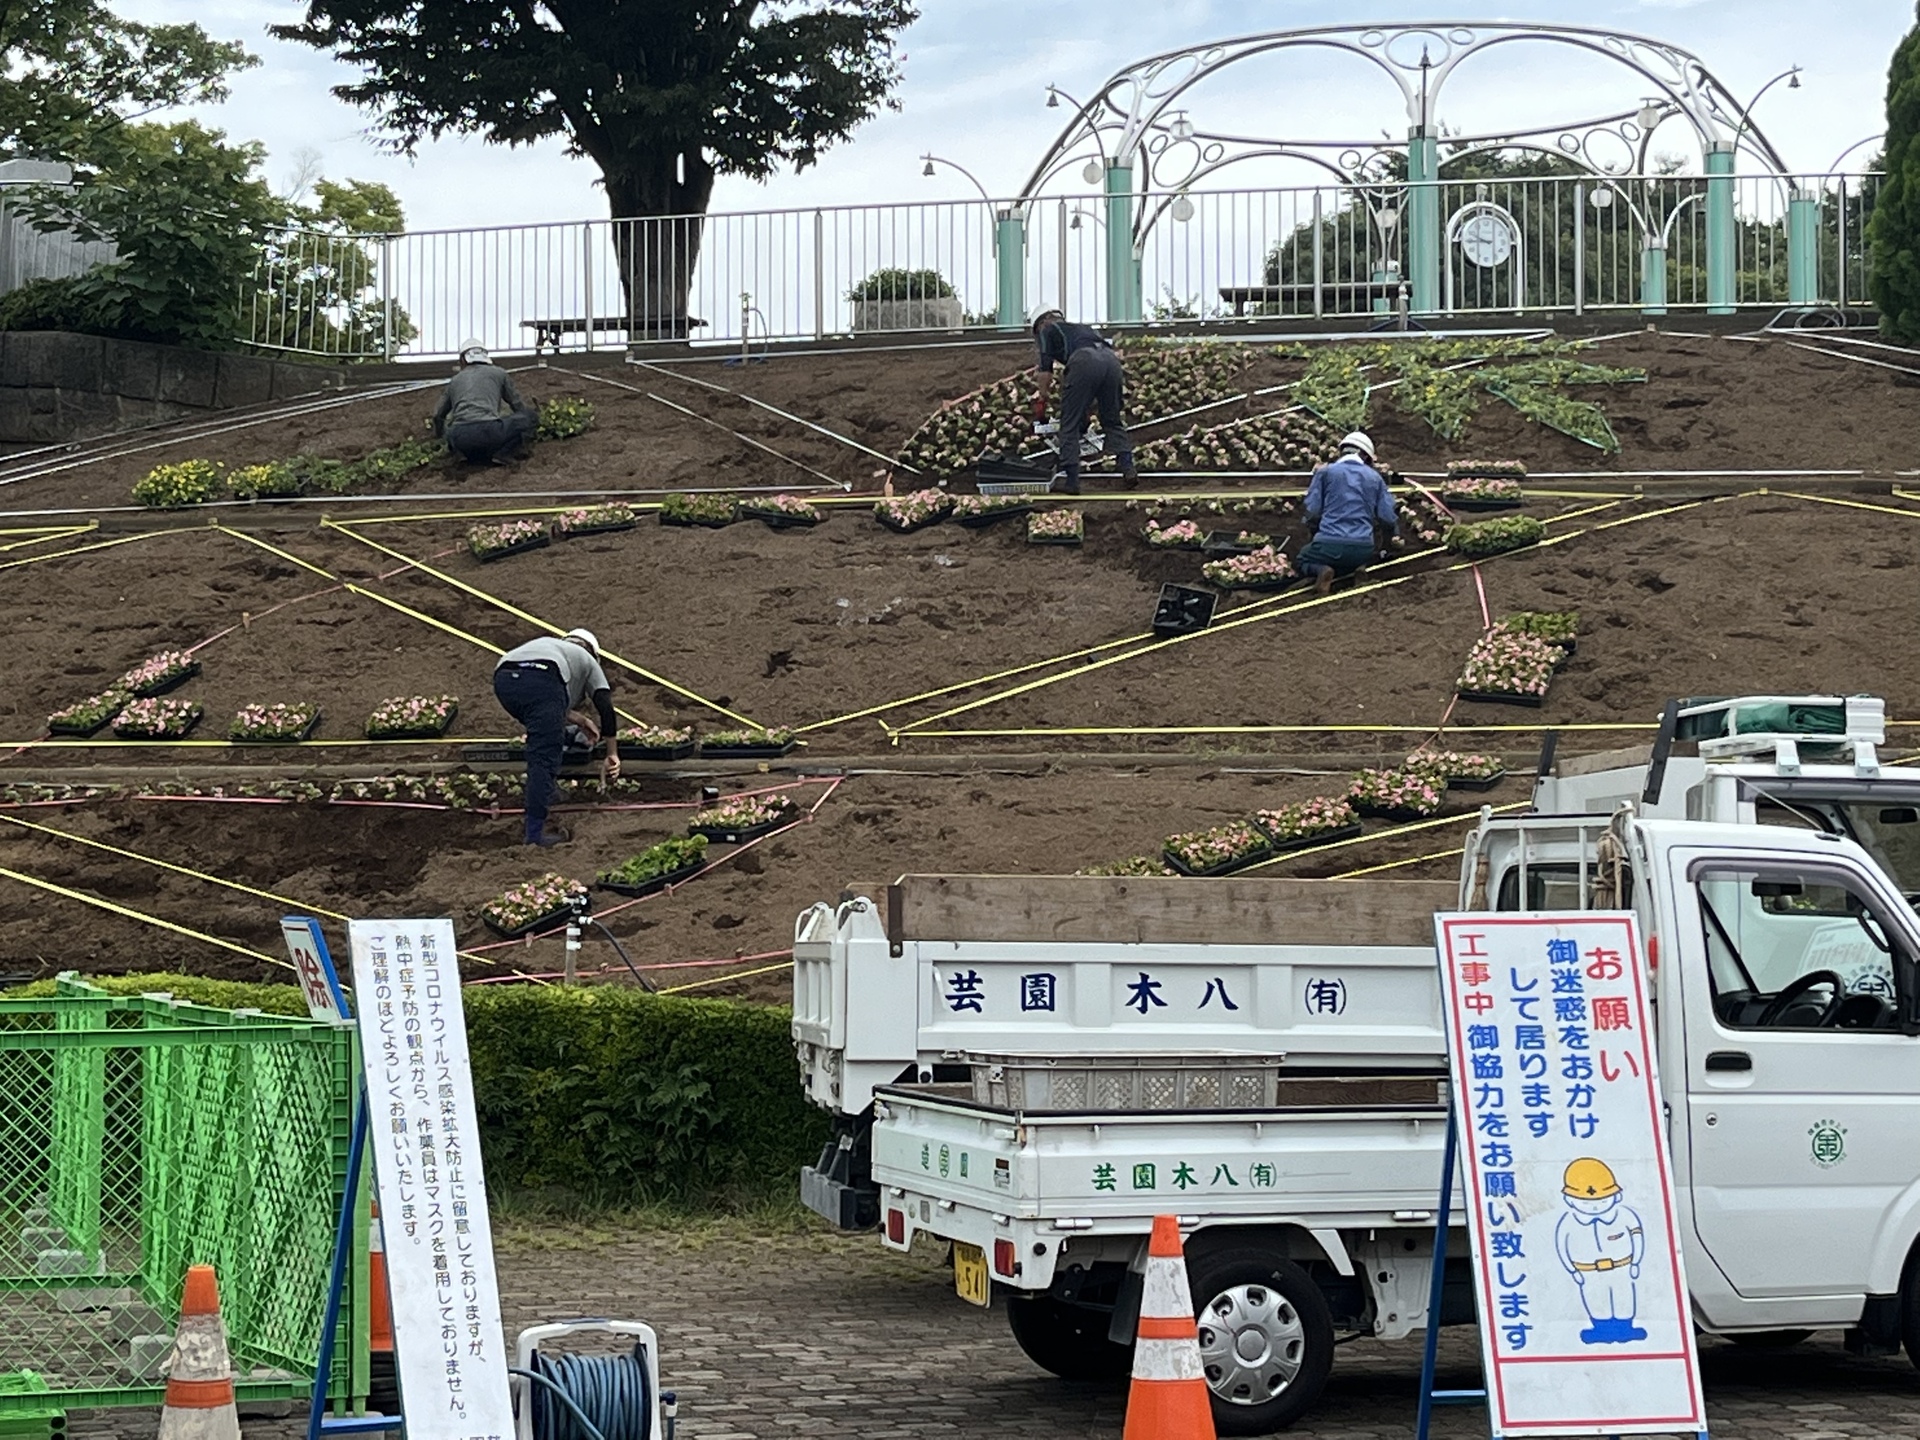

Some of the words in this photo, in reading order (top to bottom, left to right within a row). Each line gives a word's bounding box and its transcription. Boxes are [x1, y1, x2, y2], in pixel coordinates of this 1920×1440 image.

[1458, 934, 1494, 1016] 工事中
[1510, 967, 1554, 1138] して居ります
[1546, 938, 1599, 1139] 御迷惑をおかけ
[1585, 947, 1639, 1082] お願い
[1467, 1024, 1533, 1350] 御協力をお願い致します
